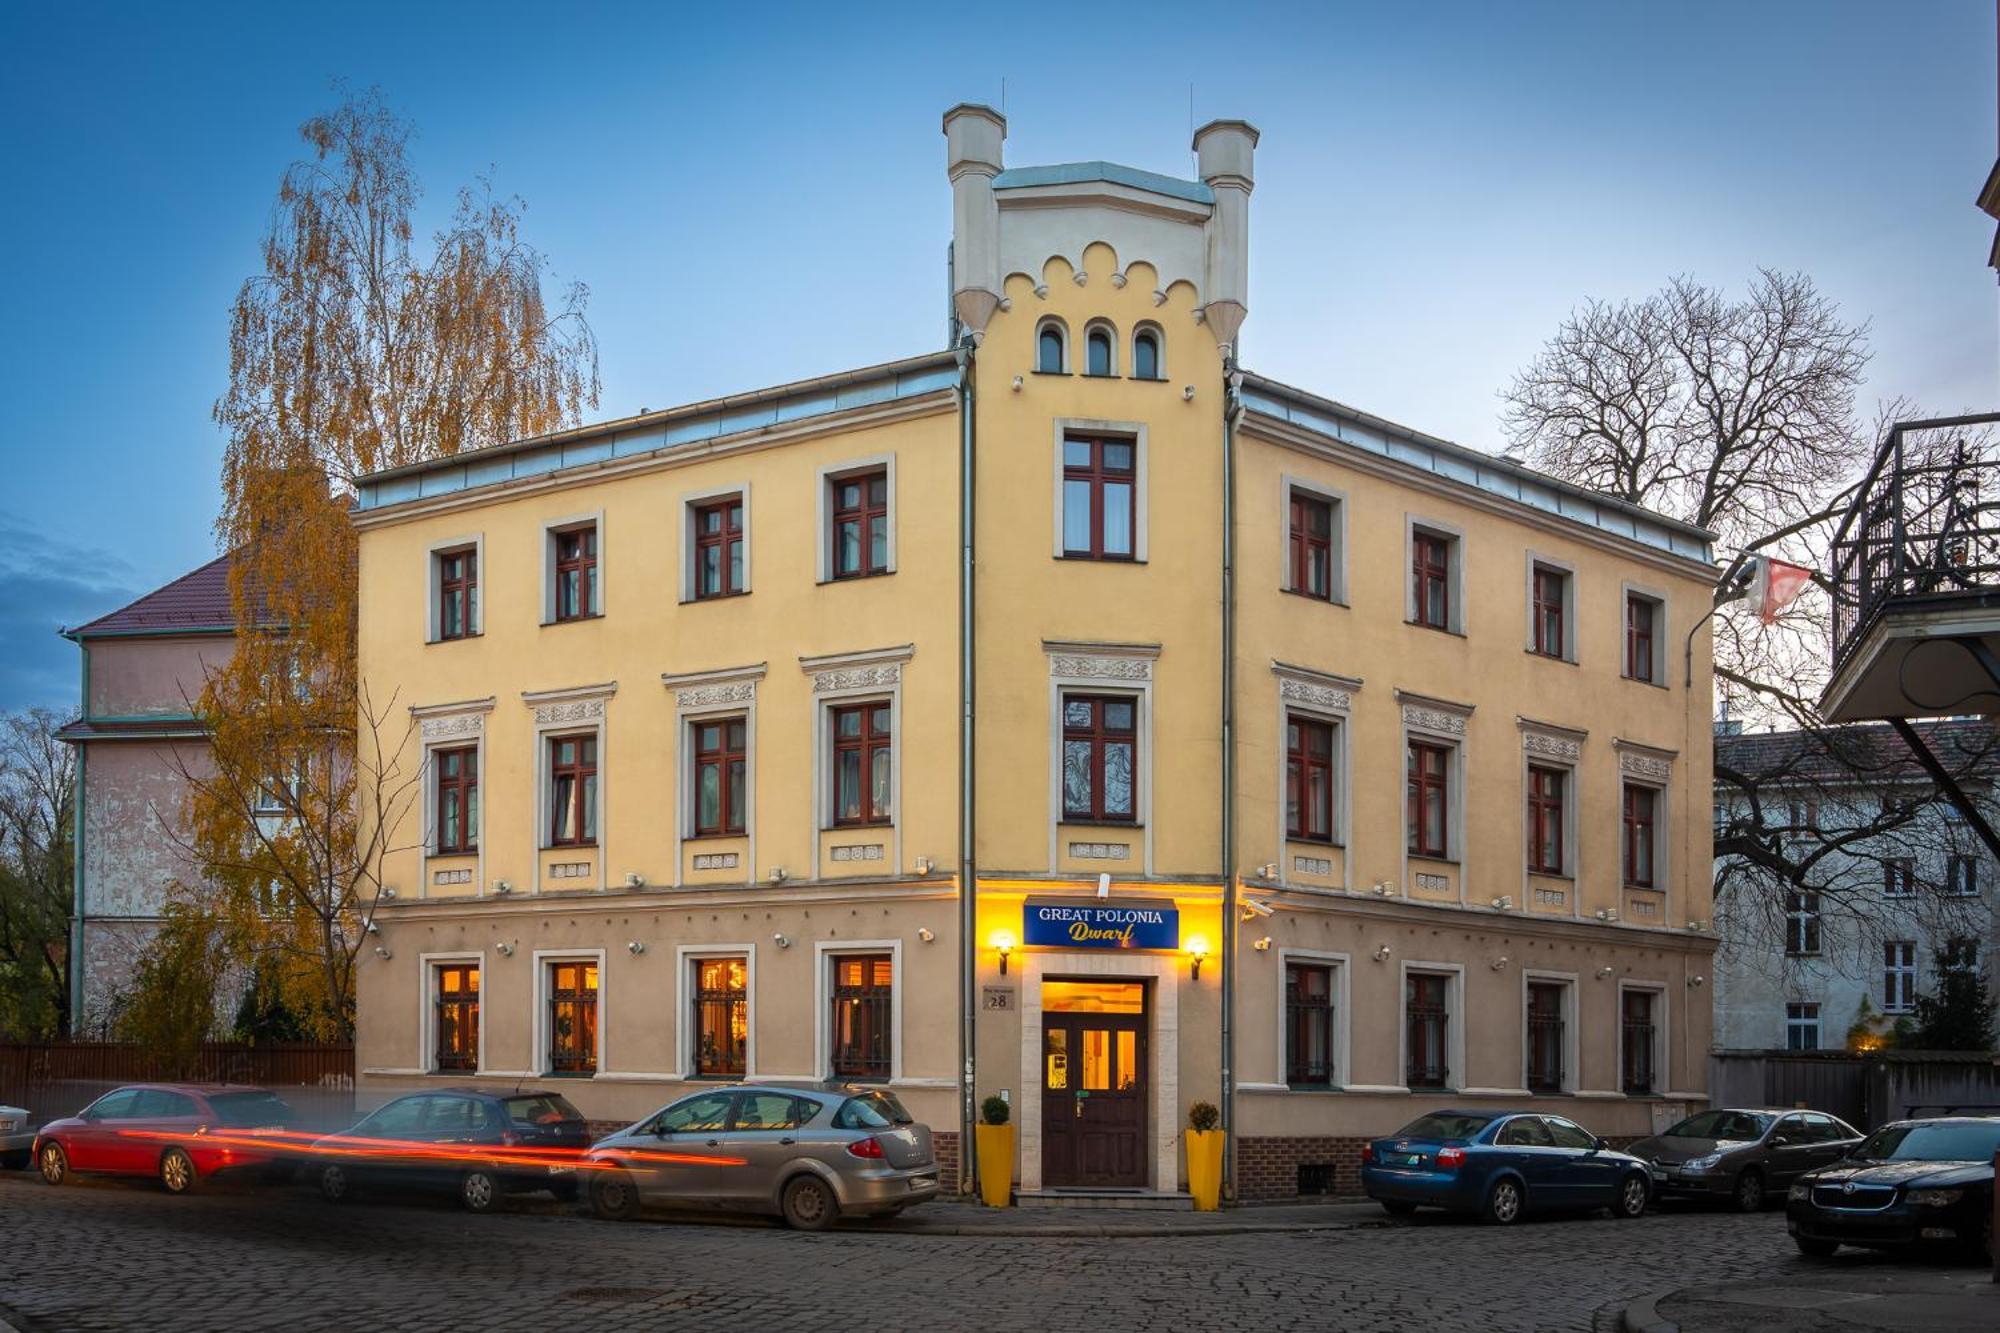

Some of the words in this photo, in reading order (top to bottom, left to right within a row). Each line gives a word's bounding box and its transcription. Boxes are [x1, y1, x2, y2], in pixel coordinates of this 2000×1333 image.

[1039, 908, 1092, 921] GREAT
[1096, 909, 1163, 923] POLONIA
[1068, 921, 1134, 948] Dwarf
[991, 995, 1006, 1007] 28
